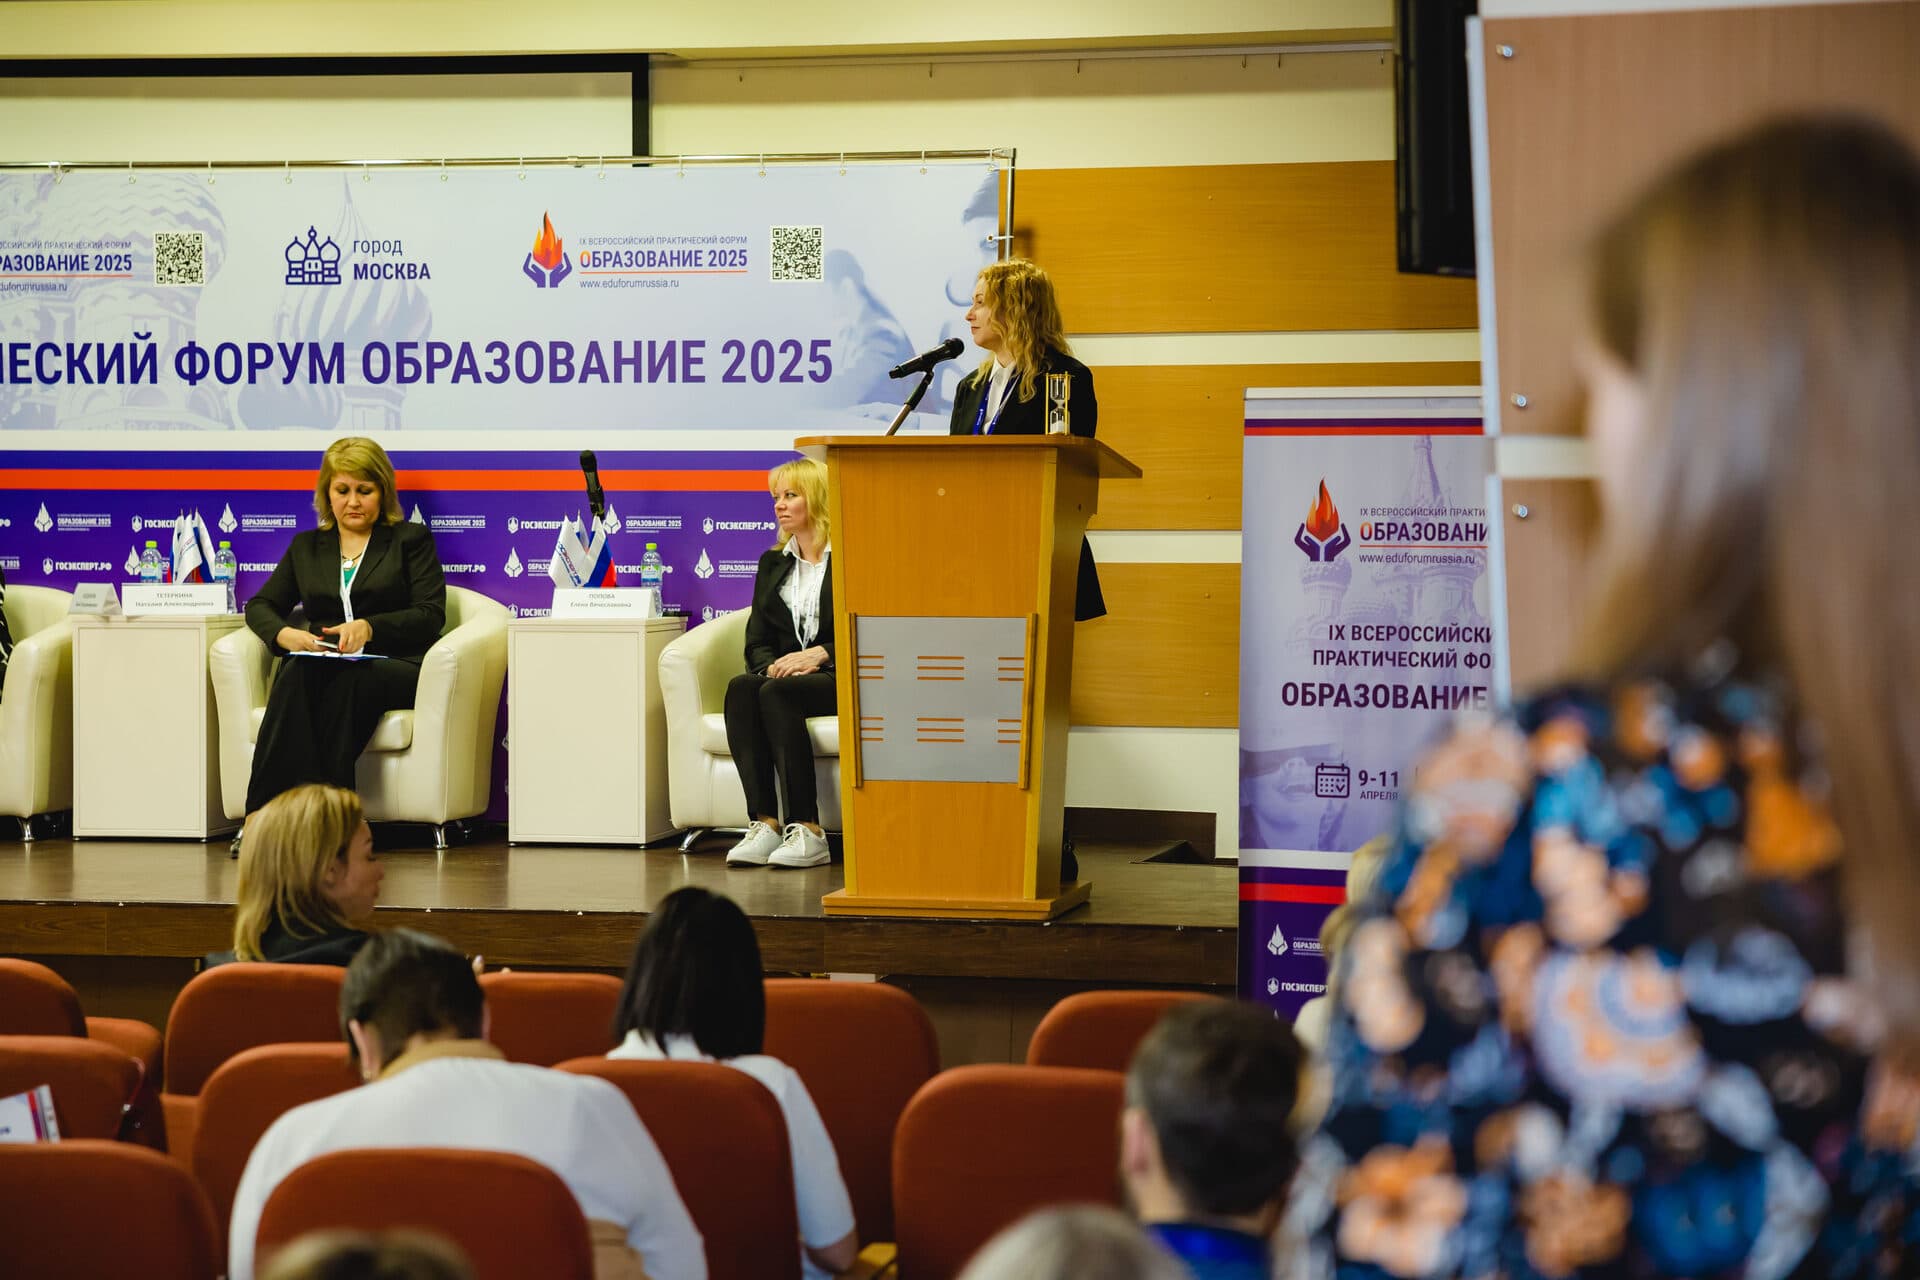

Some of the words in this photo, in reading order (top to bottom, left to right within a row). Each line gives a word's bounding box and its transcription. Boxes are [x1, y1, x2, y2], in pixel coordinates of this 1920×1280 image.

[105, 241, 131, 249] ФОРУМ
[353, 240, 402, 257] город
[588, 237, 654, 246] ВСЕРОССИЙСКИЙ
[657, 236, 717, 245] ПРАКТИЧЕСКИЙ
[719, 236, 747, 244] ФОРУМ
[0, 254, 90, 271] АЗОВАНИЕ
[94, 254, 132, 271] 2025
[580, 250, 703, 268] ОБРАЗОВАНИЕ
[708, 249, 748, 267] 2025
[353, 263, 431, 280] МОСКВА
[580, 278, 679, 288] www.eduforumrussia.ru
[0, 332, 158, 385] ЕСКИЙ
[174, 341, 345, 386] ФОРУМ
[362, 340, 706, 385] ОБРАЗОВАНИЕ
[721, 339, 833, 384] 2025
[1371, 506, 1447, 517] ВСЕРОССИЙСКИЙ
[1450, 508, 1485, 516] ПРАКТИ
[716, 522, 776, 530] ГОСЭКСПЕРТ.РФ
[1360, 522, 1488, 542] ОБРАЗОВАНИ
[55, 562, 112, 571] ГОСЭКСПЕРТ.РФ
[1359, 553, 1475, 564] www.eduforumrussia.ru
[1329, 625, 1345, 641] IX
[1313, 648, 1457, 668] ПРАКТИЧЕСКИЙ
[1464, 652, 1491, 669] ФО
[1282, 682, 1488, 711] ОБРАЗОВАНИЕ
[1358, 770, 1399, 787] 9-11
[1360, 791, 1399, 800] АПРЕЛЯ
